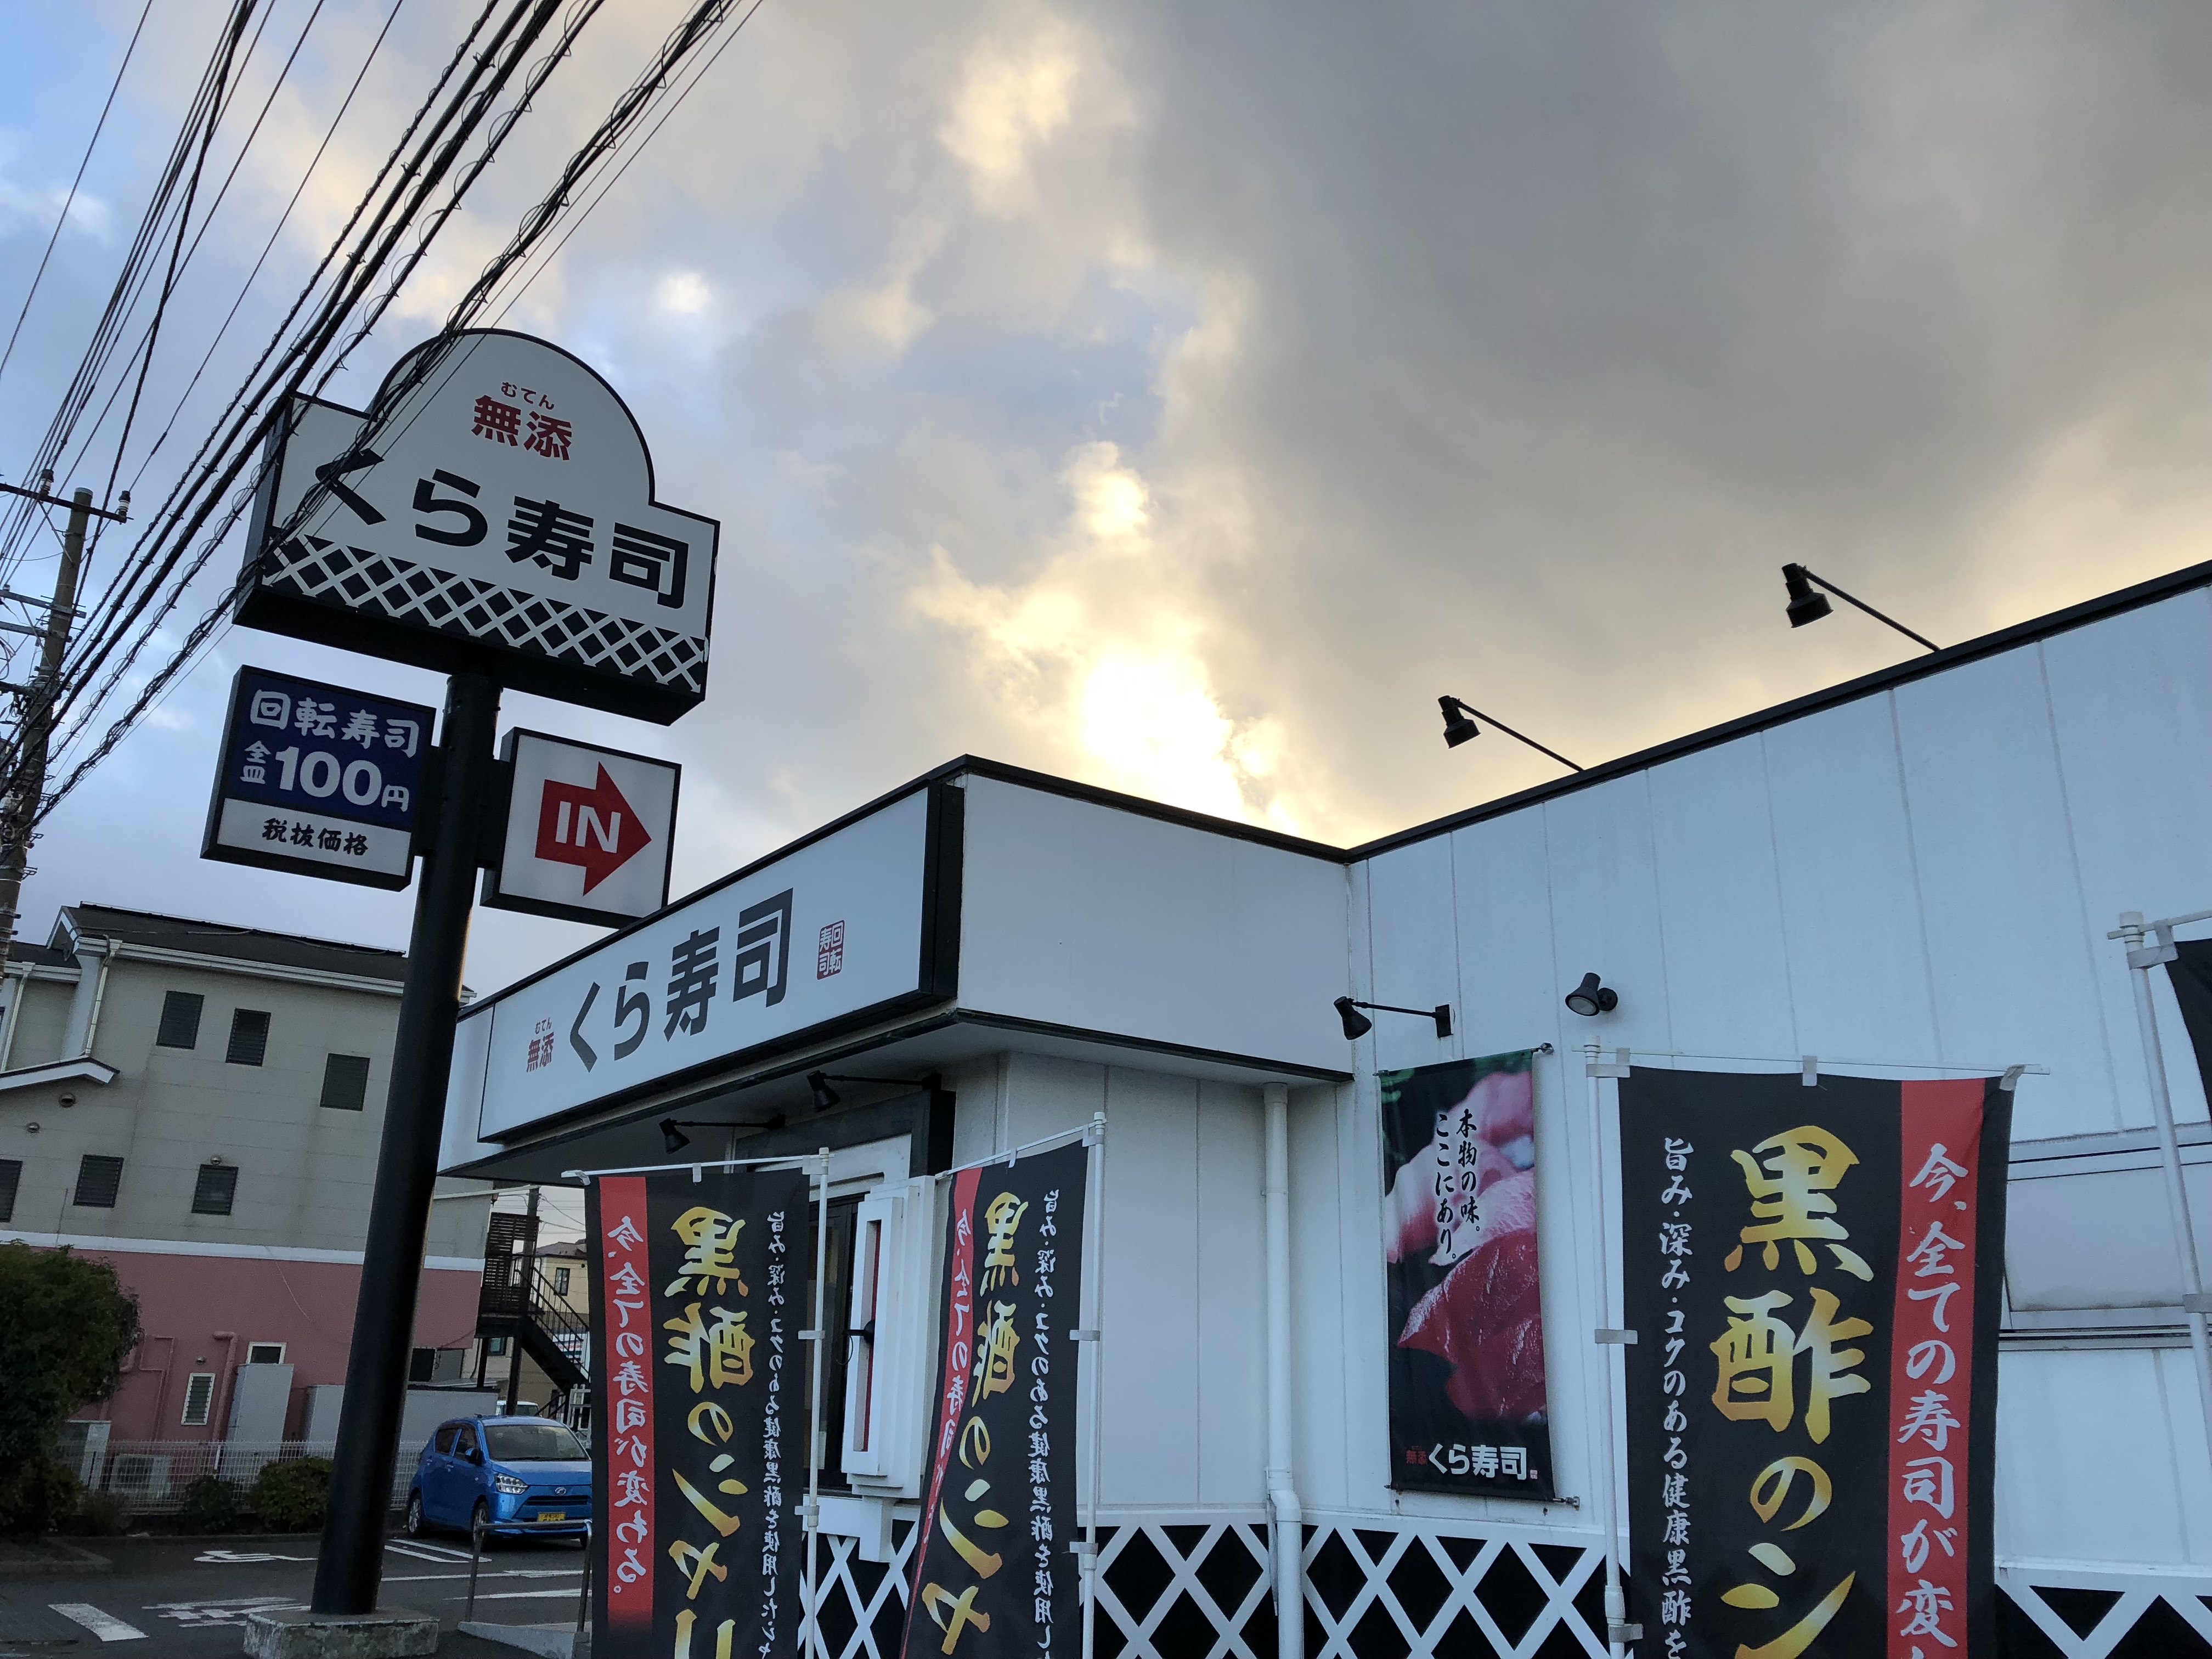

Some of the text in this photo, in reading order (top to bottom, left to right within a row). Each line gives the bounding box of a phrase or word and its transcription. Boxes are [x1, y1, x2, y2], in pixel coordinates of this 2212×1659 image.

[500, 381, 555, 411] むてん
[471, 394, 573, 461] 無添
[314, 447, 689, 610] くら寿司
[250, 689, 420, 758] 回転寿司
[240, 740, 272, 785] 全皿
[262, 817, 369, 856] 税抜価格
[555, 801, 621, 854] IN
[569, 887, 794, 1073] くら寿司
[526, 1031, 555, 1073] 無添
[534, 1017, 552, 1035] むてん
[1435, 1113, 1457, 1260] ここにあり。
[1456, 1108, 1480, 1232] 本物の味。
[1896, 1143, 1968, 1659] 今、全ての寿司が変
[1429, 1443, 1527, 1480] くら寿司
